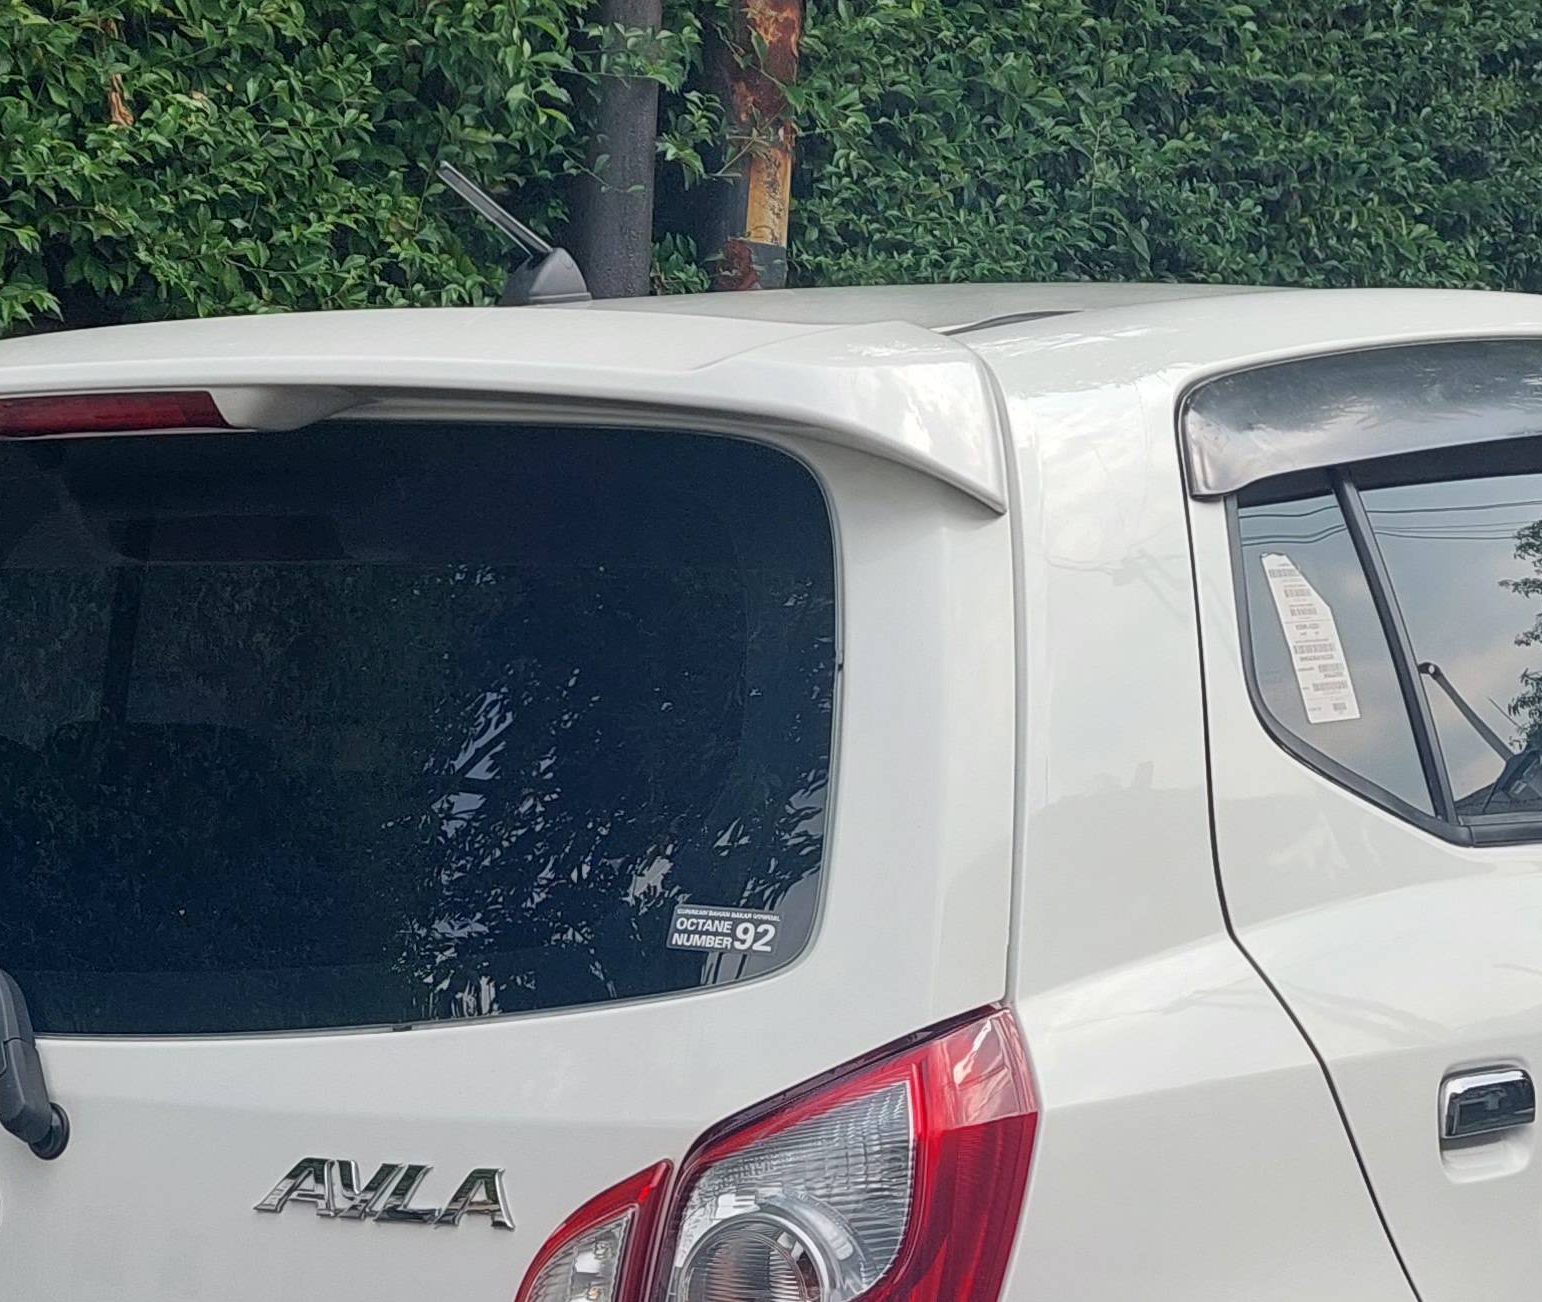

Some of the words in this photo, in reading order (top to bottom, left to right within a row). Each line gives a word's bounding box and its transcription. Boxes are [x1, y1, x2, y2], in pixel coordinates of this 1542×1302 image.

[675, 917, 733, 933] OCTANE
[671, 933, 733, 949] NUMBER
[733, 922, 776, 952] 92
[253, 1157, 516, 1231] AYLA
